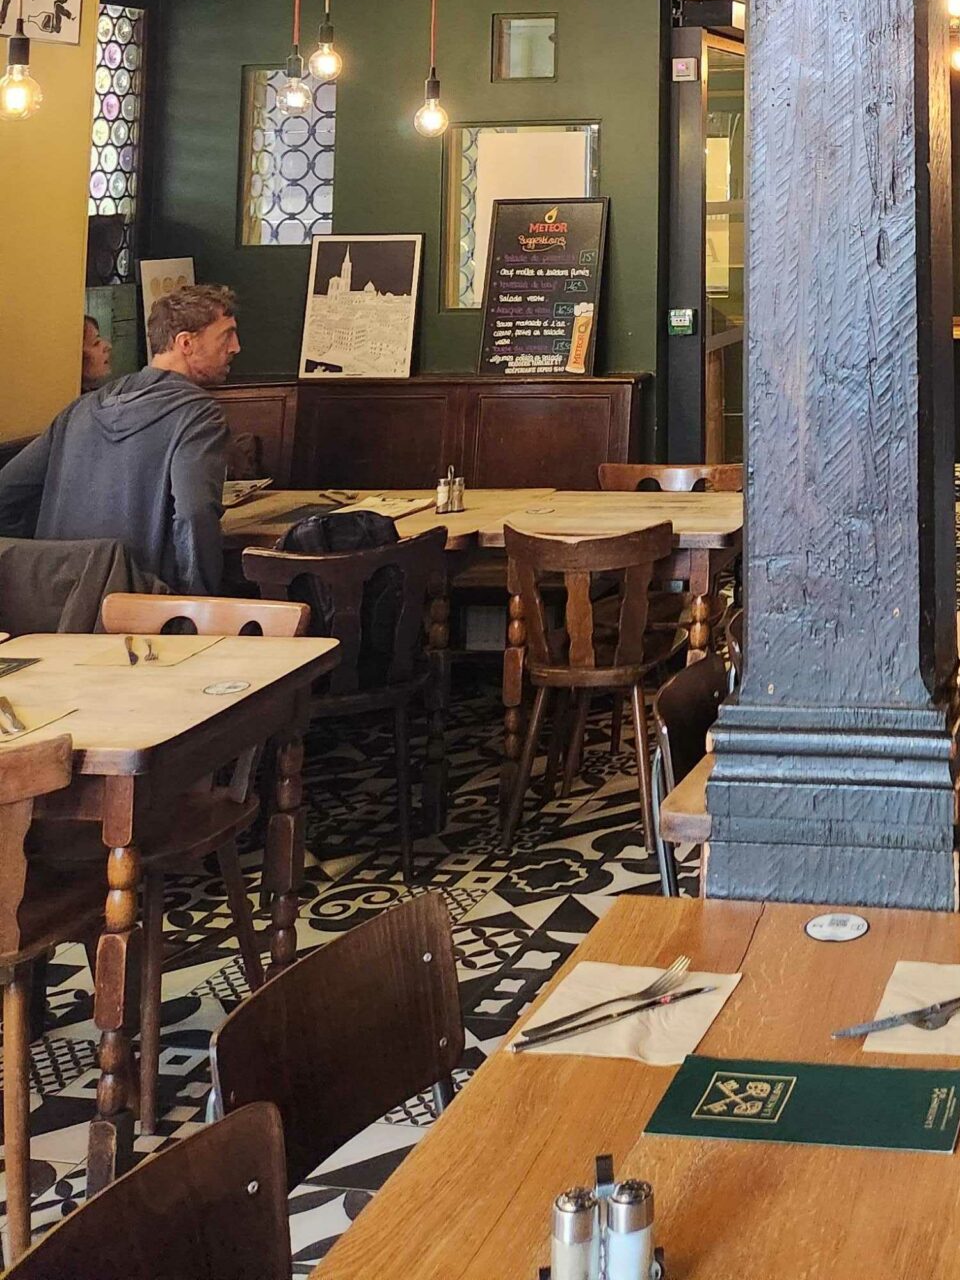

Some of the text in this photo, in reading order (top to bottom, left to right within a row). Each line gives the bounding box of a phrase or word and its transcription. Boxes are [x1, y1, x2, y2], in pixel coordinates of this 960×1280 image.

[529, 223, 568, 233] METEOR
[518, 235, 566, 249] Suggestions
[573, 335, 585, 365] METEOR
